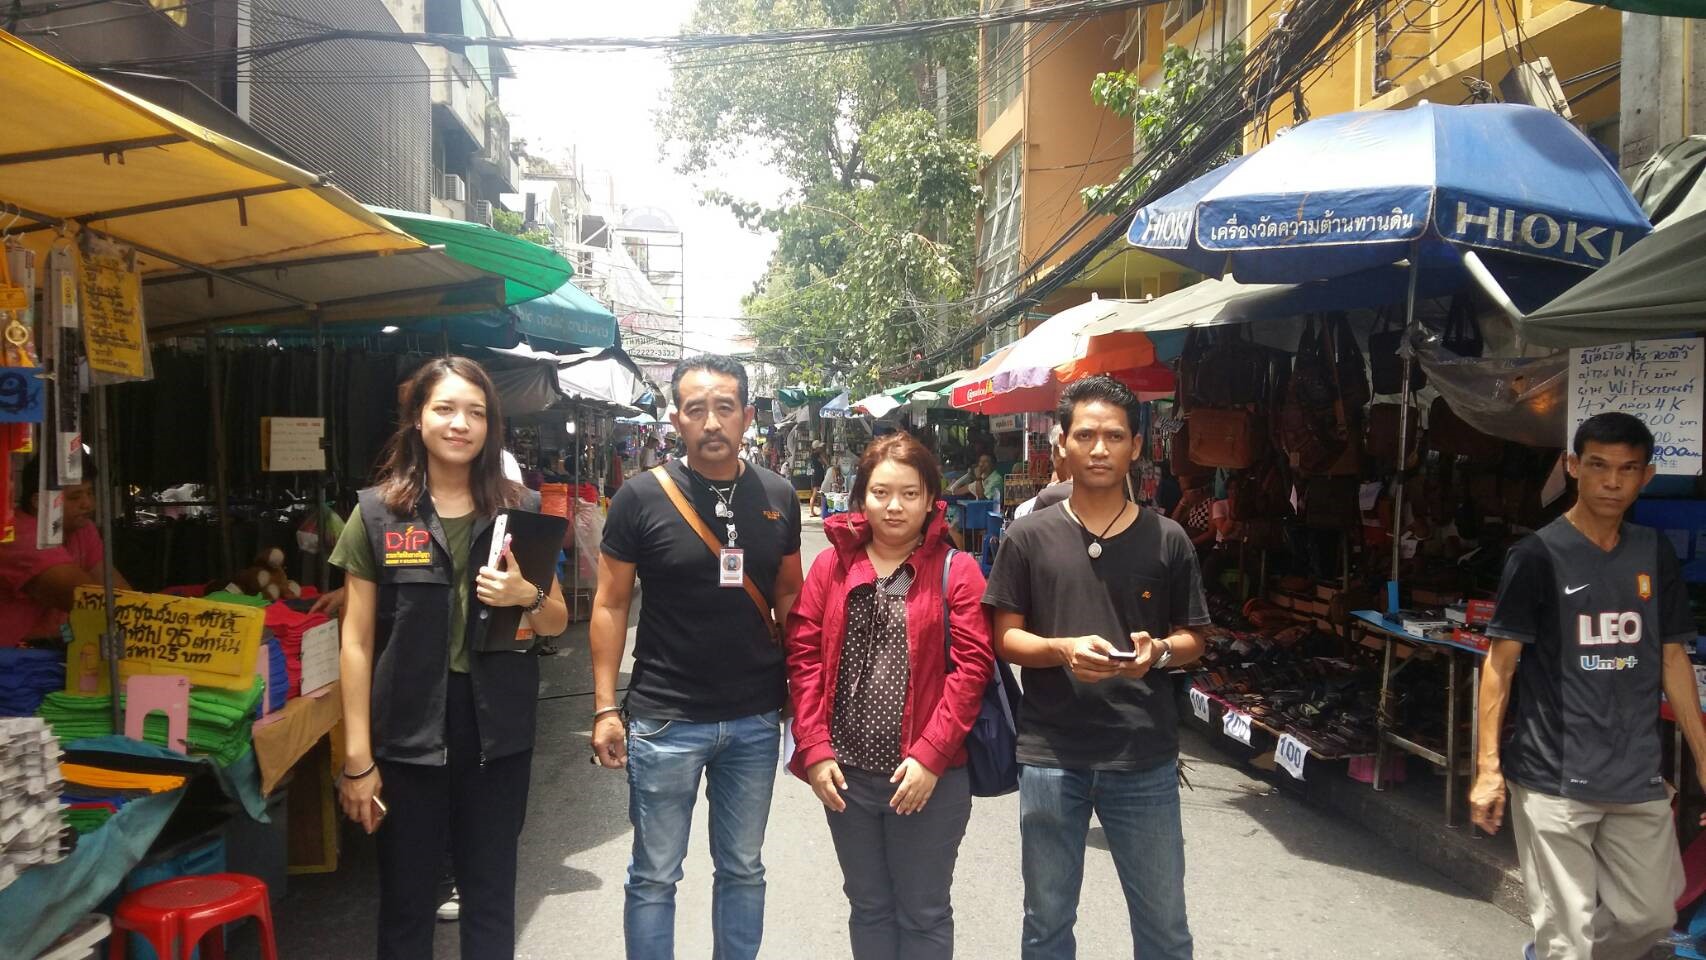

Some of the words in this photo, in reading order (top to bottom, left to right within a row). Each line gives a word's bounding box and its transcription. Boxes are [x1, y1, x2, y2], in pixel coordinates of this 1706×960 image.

[1142, 211, 1193, 241] HIOKI
[1210, 206, 1414, 241] เครื่องวัดความต้านทานดิน
[1456, 201, 1625, 264] HIOKI
[166, 627, 192, 649] 25
[1578, 611, 1643, 645] LEO
[1279, 736, 1302, 769] 100
